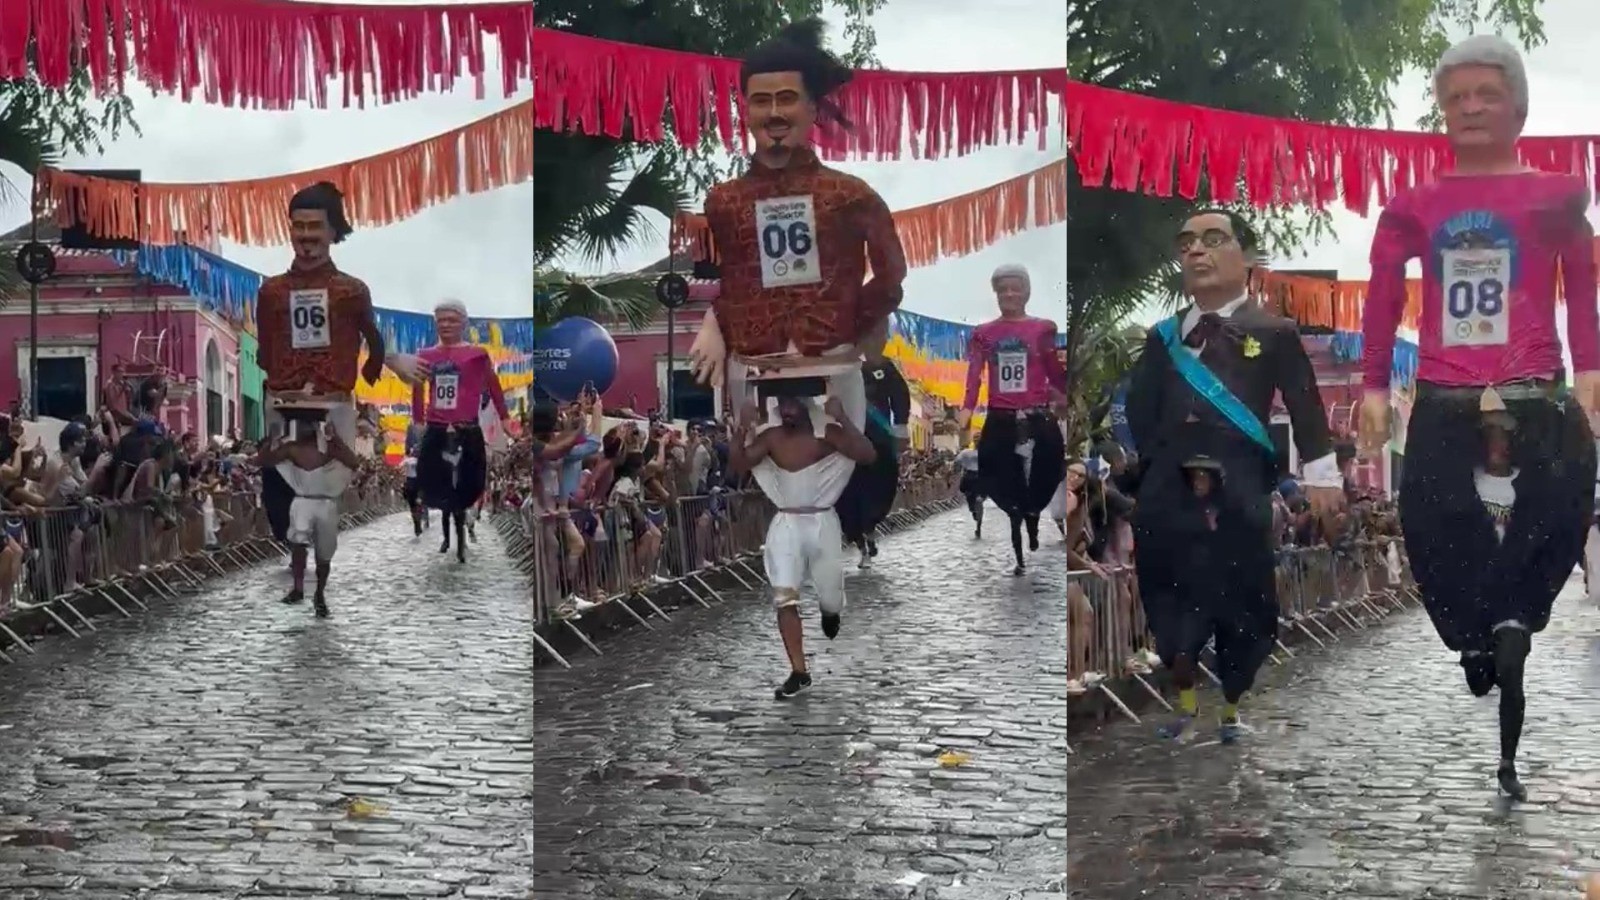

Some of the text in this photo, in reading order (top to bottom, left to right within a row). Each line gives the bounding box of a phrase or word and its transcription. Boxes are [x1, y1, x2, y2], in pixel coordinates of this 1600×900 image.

[763, 221, 812, 259] 06
[1449, 278, 1504, 318] 08
[294, 306, 326, 329] 06
[1002, 364, 1025, 382] 08
[436, 385, 455, 400] 08
